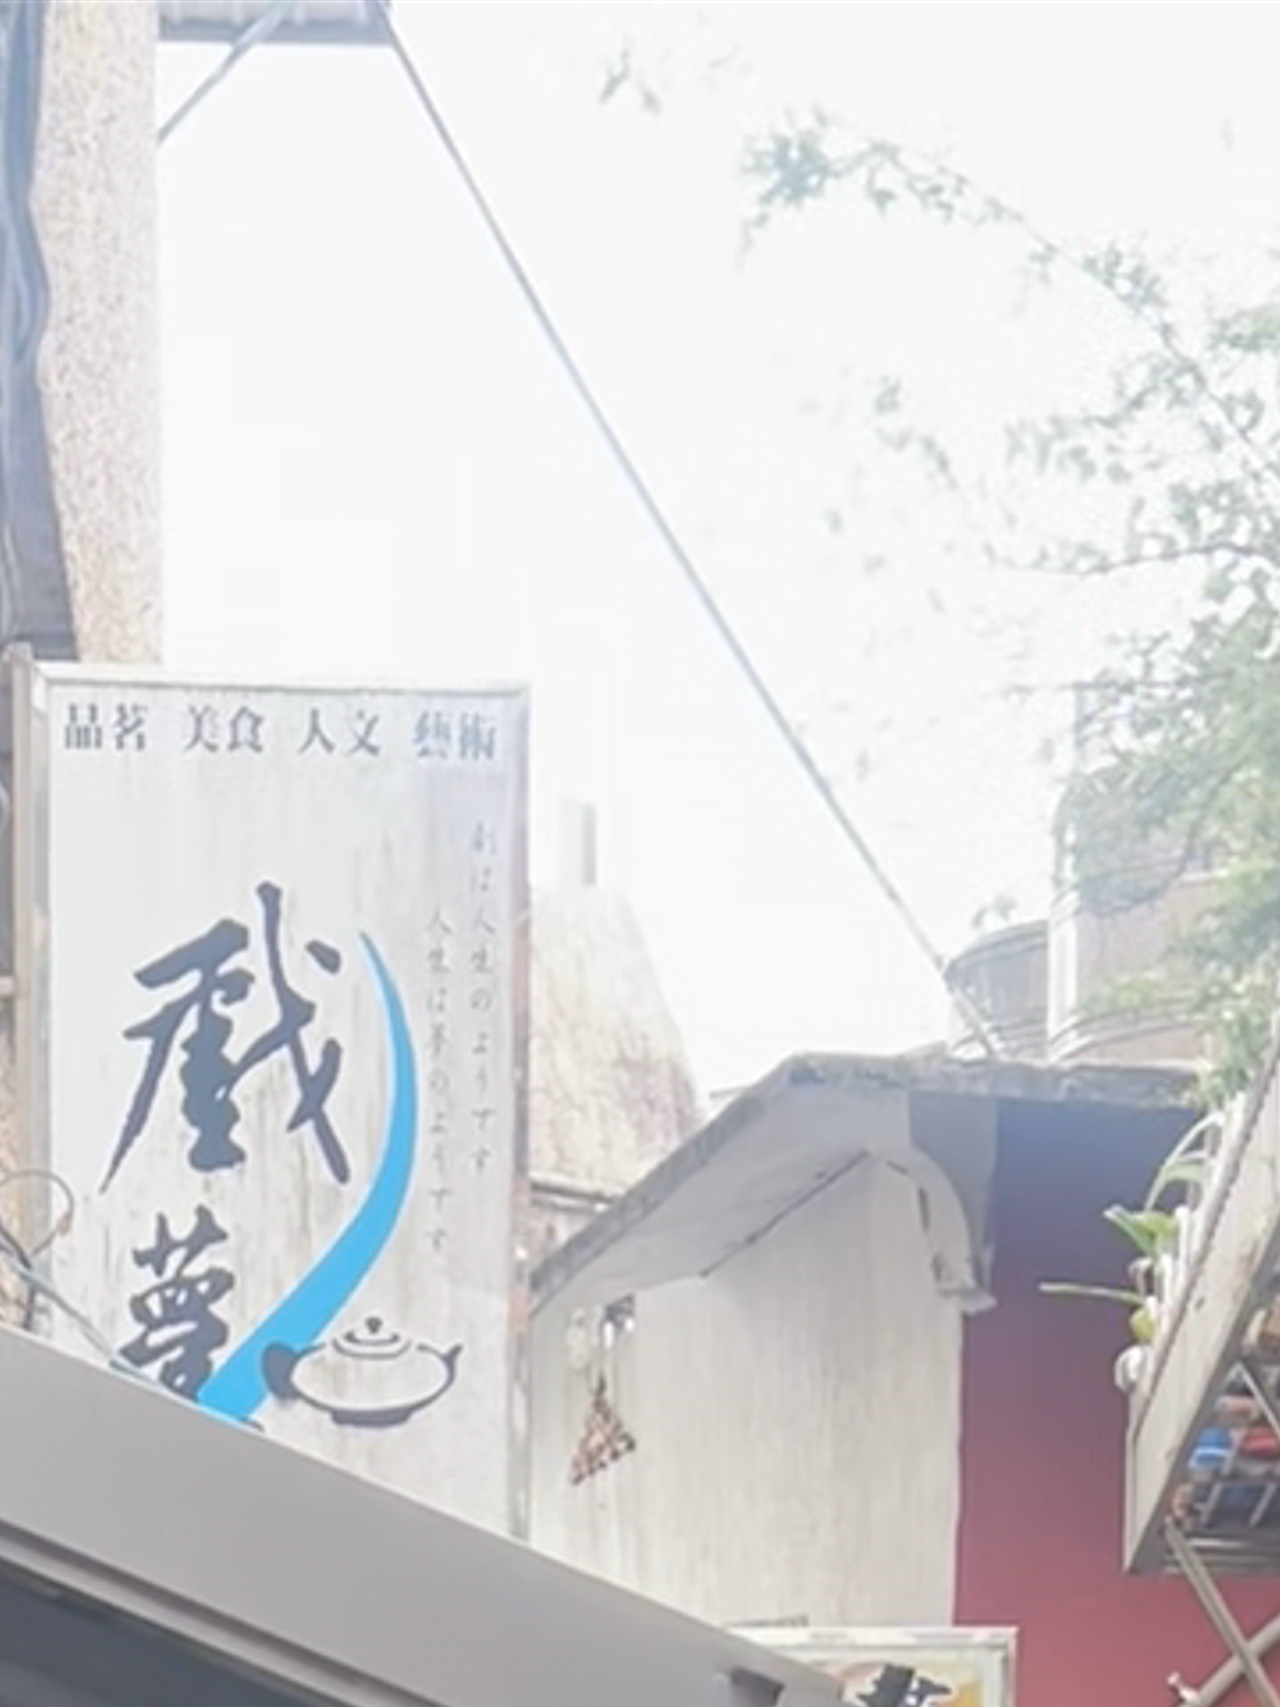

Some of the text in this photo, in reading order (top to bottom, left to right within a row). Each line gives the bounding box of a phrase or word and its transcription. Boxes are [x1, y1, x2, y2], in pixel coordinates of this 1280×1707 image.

[64, 702, 497, 761] 品茗 美食 人文 藝術
